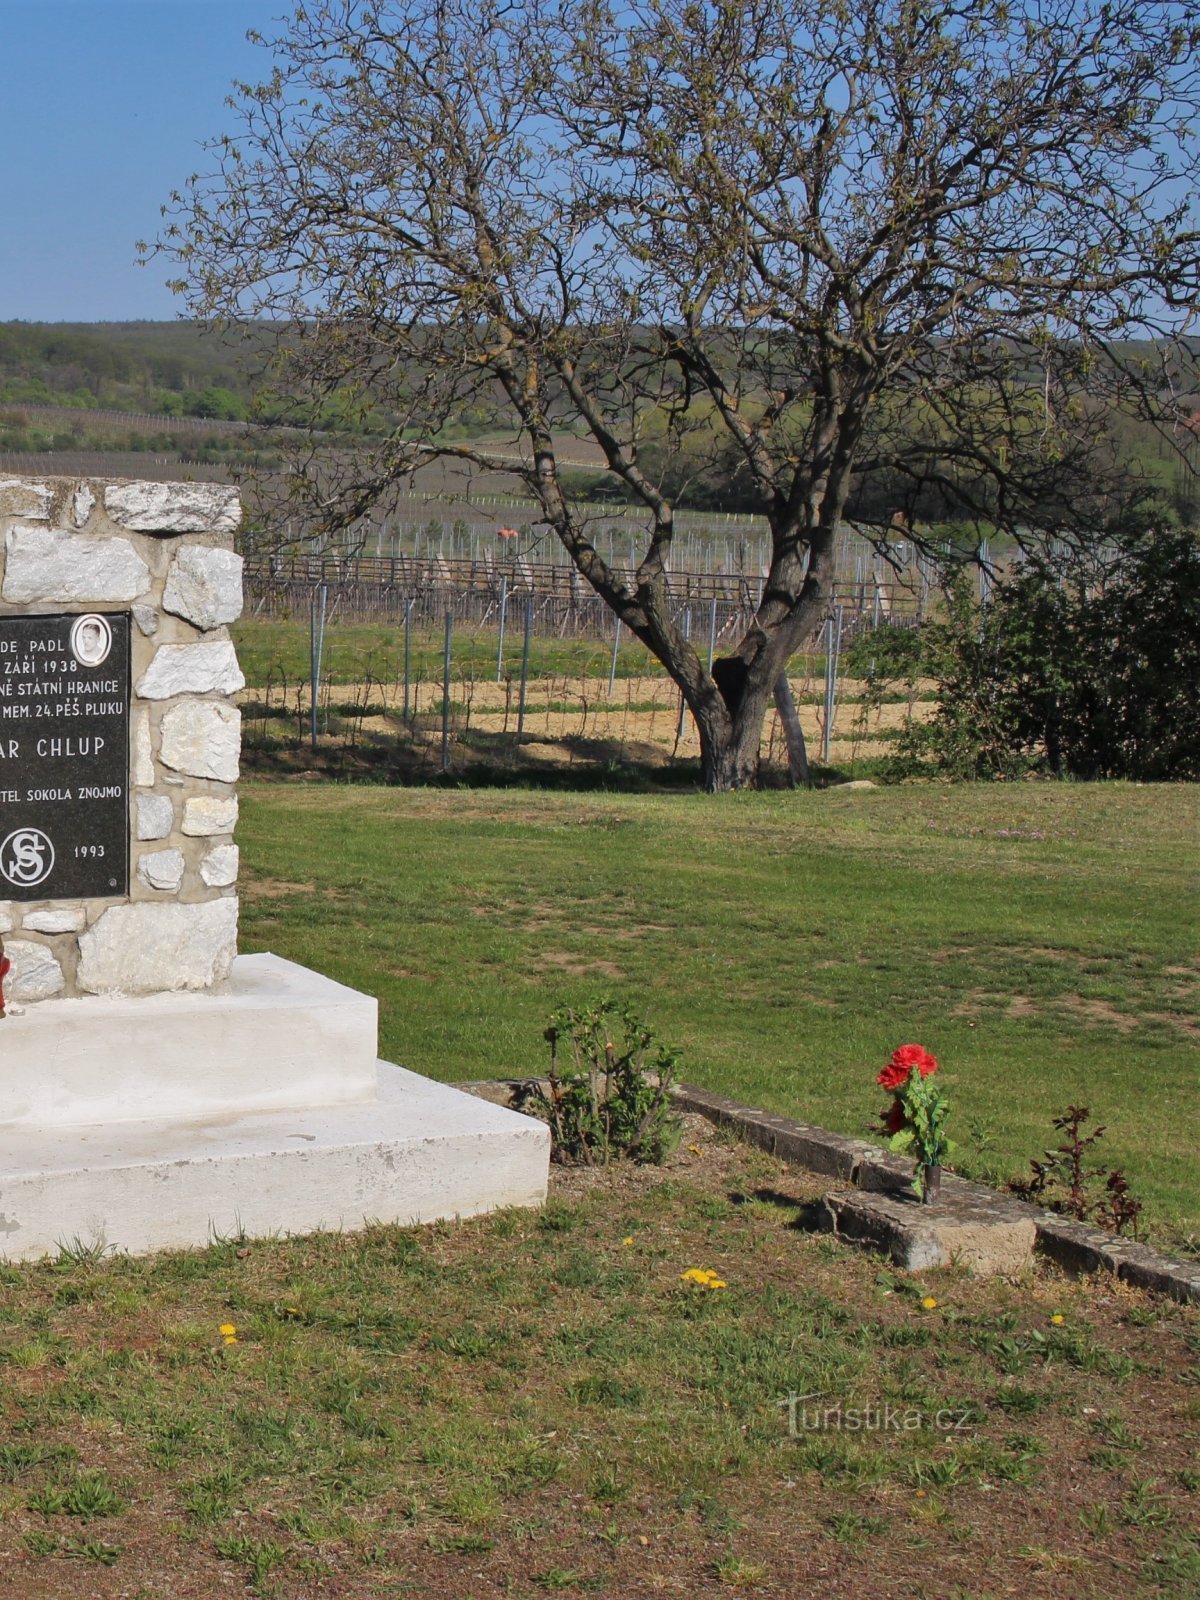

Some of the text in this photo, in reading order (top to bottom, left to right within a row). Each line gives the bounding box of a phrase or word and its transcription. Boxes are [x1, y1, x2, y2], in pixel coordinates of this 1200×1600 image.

[29, 639, 65, 652] PADL
[4, 654, 35, 674] ZÁŘÍ
[44, 660, 77, 673] 1938
[17, 677, 62, 695] STÁTNÍ
[67, 680, 119, 694] HRANICE
[3, 705, 32, 719] MEM.
[35, 704, 53, 717] 24.
[56, 698, 83, 716] PĚŠ.
[85, 702, 123, 715] PLUKU
[36, 737, 105, 757] CHLUP
[27, 788, 72, 802] SOKOLA
[78, 786, 122, 799] ZNOJMO
[74, 846, 105, 858] 1993
